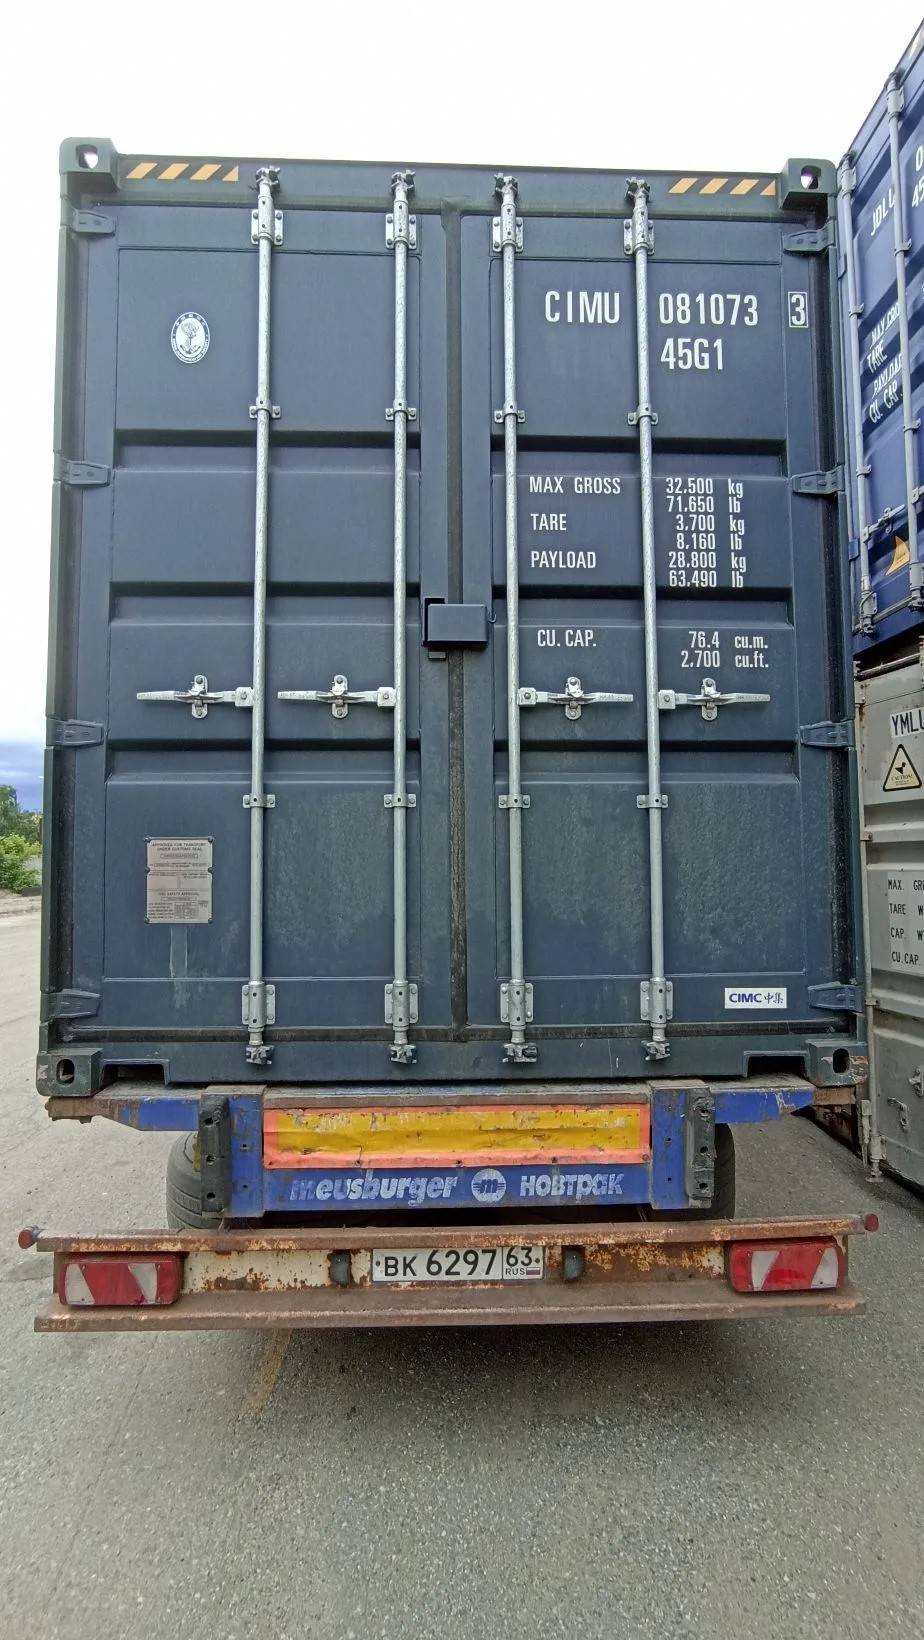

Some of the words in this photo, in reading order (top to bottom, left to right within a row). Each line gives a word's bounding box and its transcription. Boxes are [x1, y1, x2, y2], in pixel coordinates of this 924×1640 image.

[545, 291, 620, 324] CIMU
[658, 293, 759, 326] 081073
[790, 294, 806, 326] 3
[660, 337, 724, 370] 45G1
[529, 476, 564, 494] MAX
[574, 476, 621, 494] GROSS
[727, 478, 744, 498] kg
[728, 496, 741, 513] lb
[530, 513, 567, 531] TARE
[729, 515, 745, 535] kg
[730, 533, 743, 550] lb
[530, 550, 597, 569] PAYLOAD
[731, 551, 747, 573] kg
[731, 570, 744, 588] lb
[537, 629, 561, 647] CU.
[565, 629, 597, 647] CAP.
[688, 630, 720, 648] 76.4
[734, 635, 769, 649] cu.m.
[734, 650, 769, 668] cu.ft.
[889, 903, 906, 915] TARE
[729, 993, 762, 1003] CIMC
[426, 1249, 497, 1276] 6297
[506, 1247, 532, 1267] 63
[505, 1267, 525, 1276] RUS
